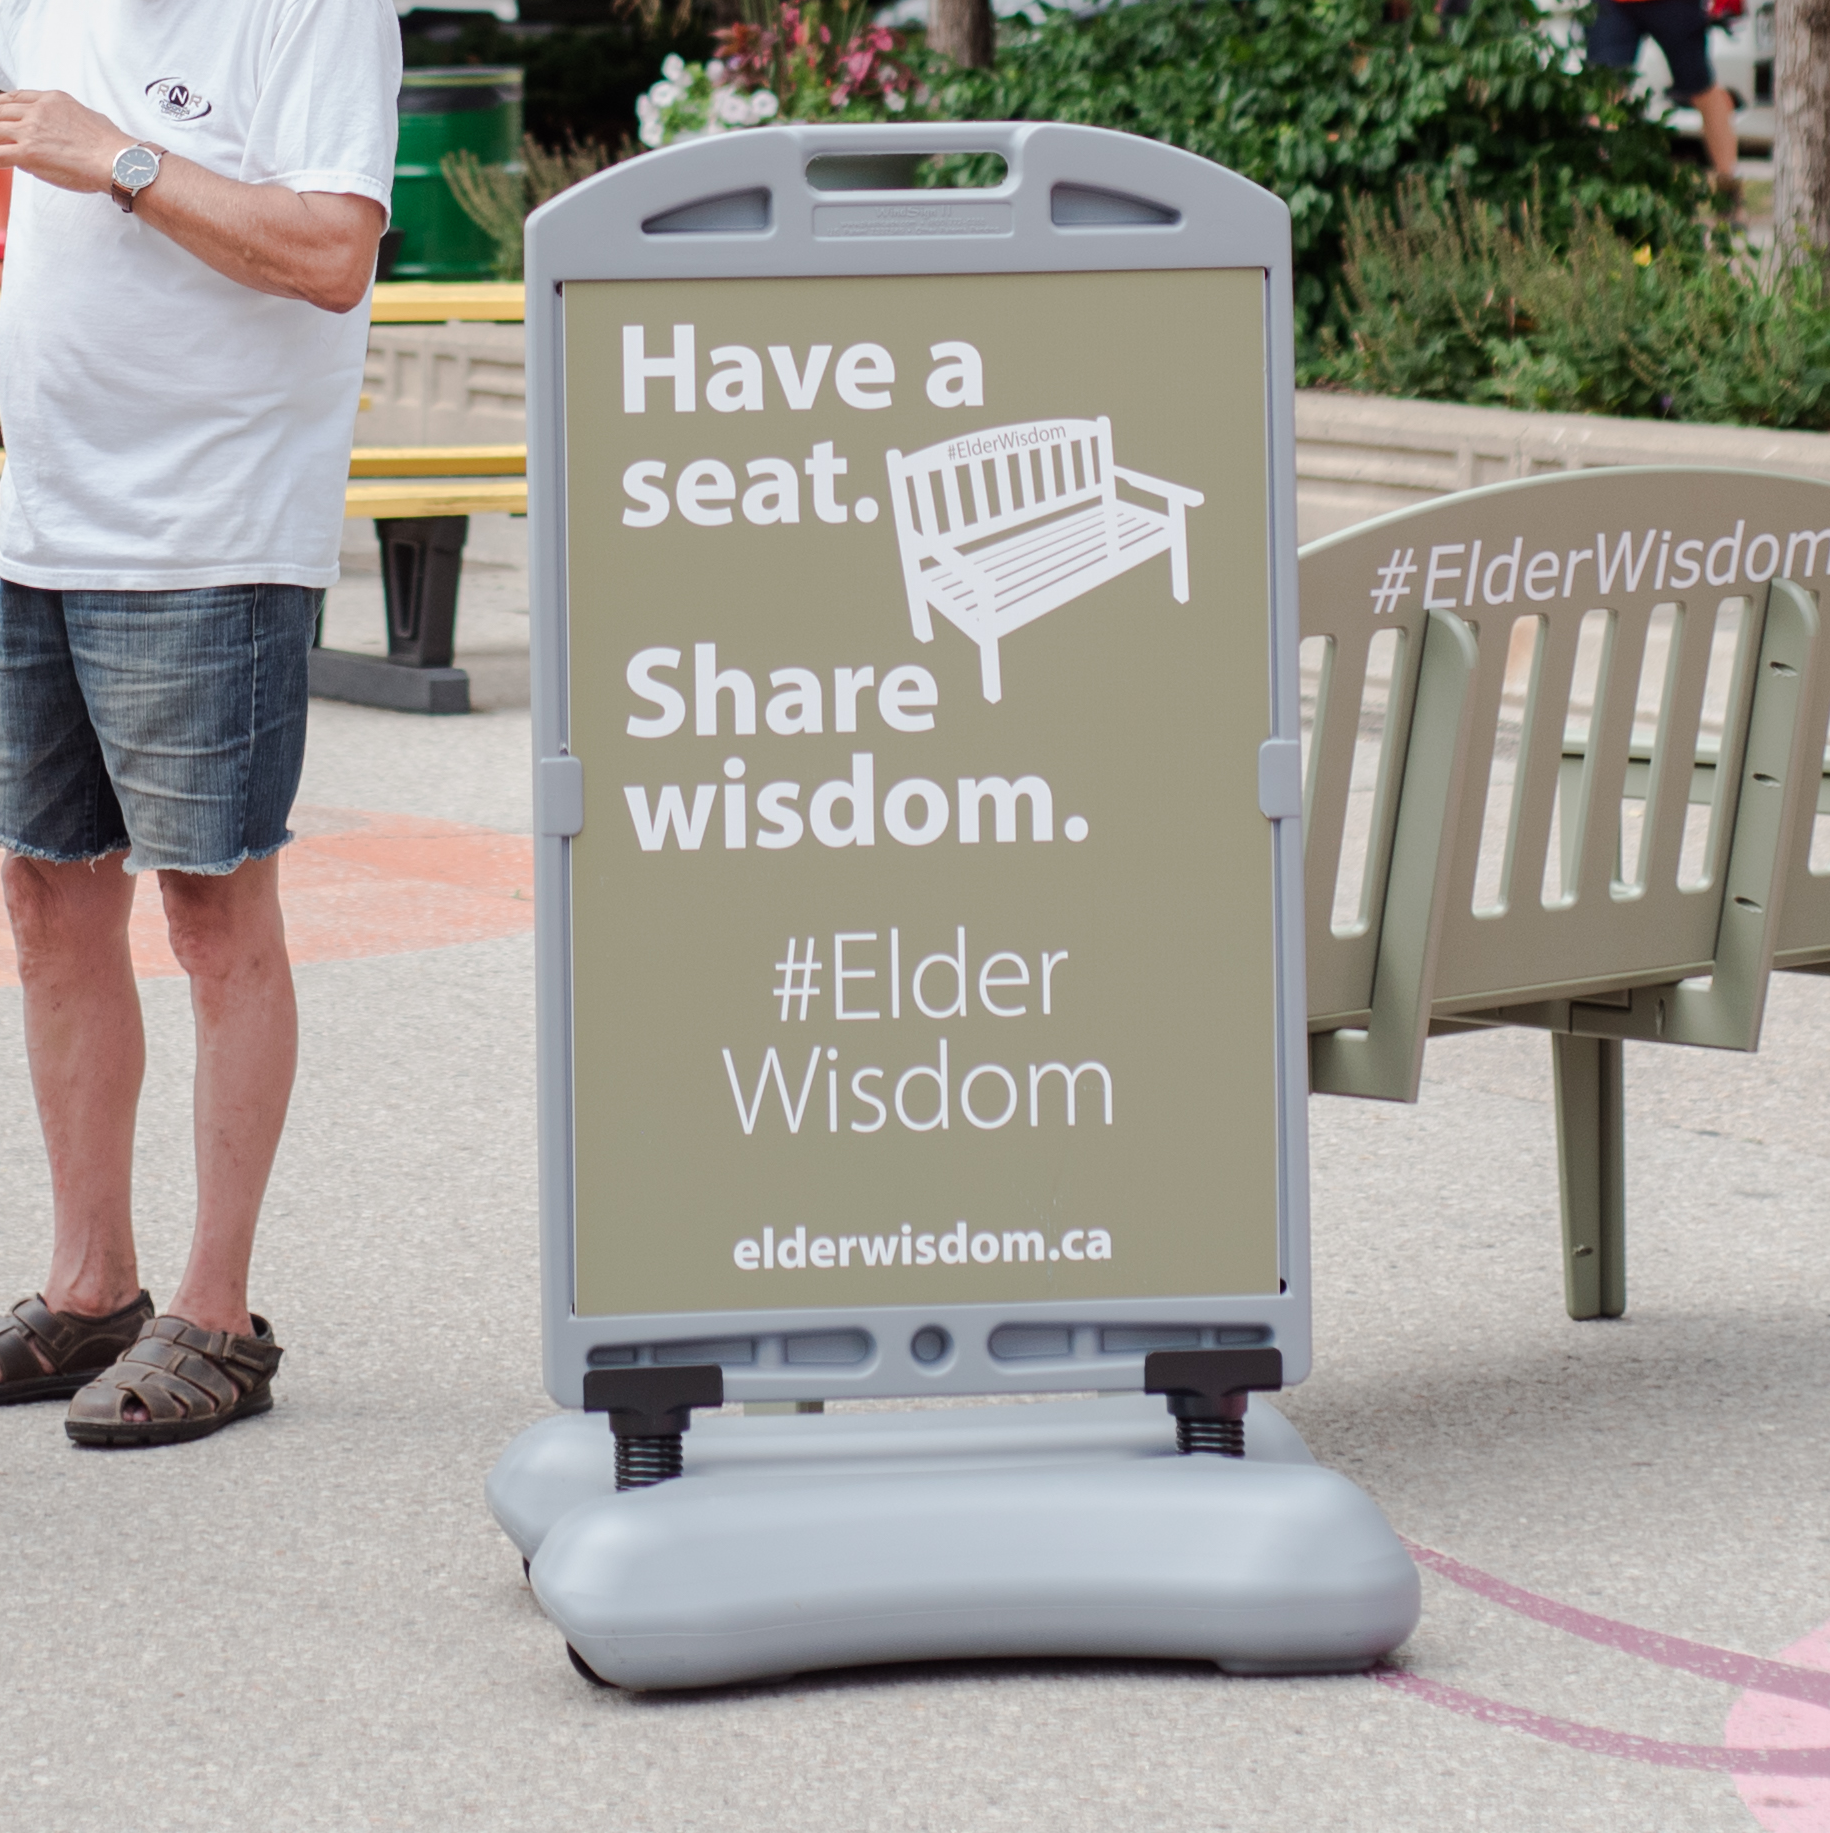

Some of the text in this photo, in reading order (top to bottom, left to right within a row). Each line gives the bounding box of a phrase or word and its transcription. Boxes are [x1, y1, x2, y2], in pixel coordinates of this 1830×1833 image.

[623, 325, 983, 413] Have a
[623, 441, 878, 527] seat.
[947, 423, 1067, 461] #ElderWisdom
[626, 642, 938, 738] Share
[624, 753, 1088, 850] wisdom.
[774, 927, 1068, 1021] #Elder
[723, 1039, 1112, 1134] Wisdom
[734, 1222, 1111, 1269] elderwisdom.ca
